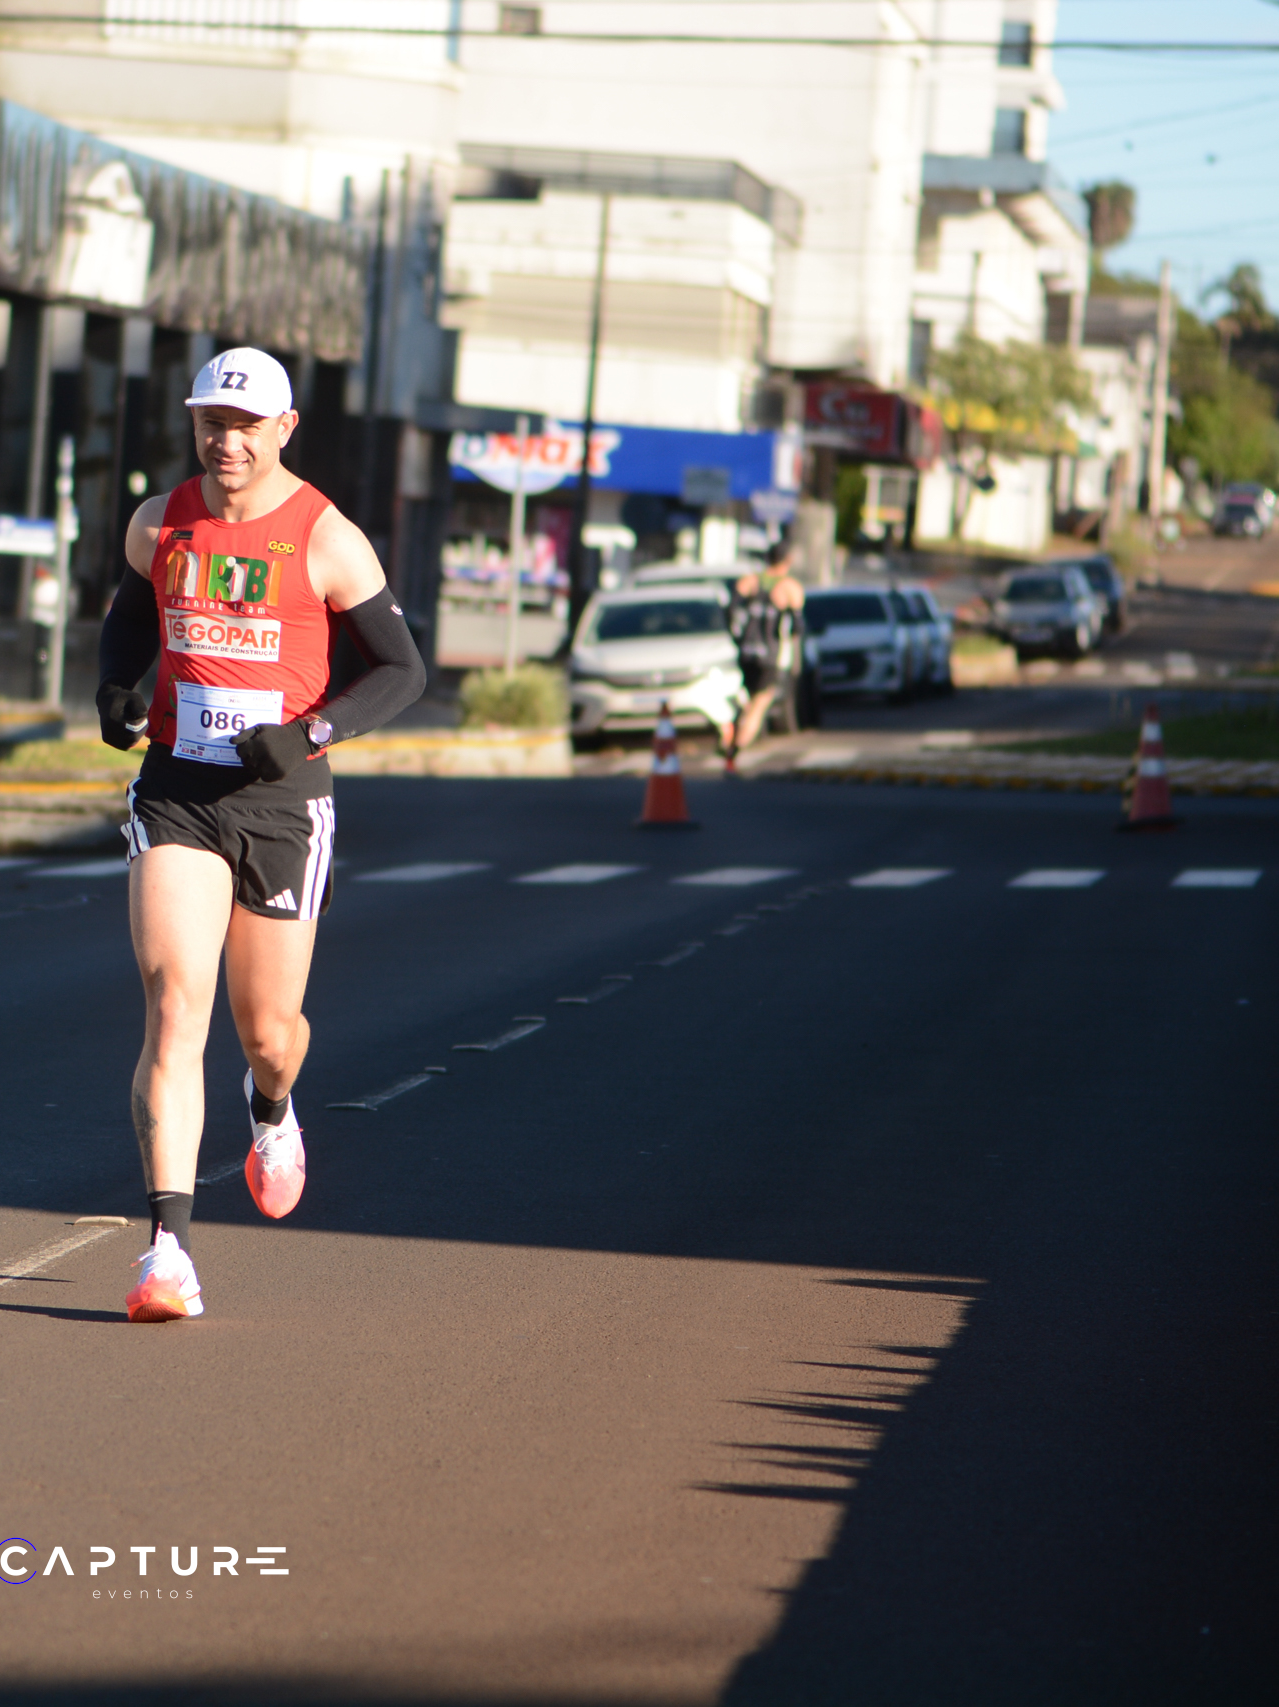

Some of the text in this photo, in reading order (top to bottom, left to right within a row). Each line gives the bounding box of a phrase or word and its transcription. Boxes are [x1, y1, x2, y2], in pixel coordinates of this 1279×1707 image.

[220, 371, 249, 391] Z2
[171, 597, 266, 614] running team
[184, 642, 219, 651] MATERIAIS
[200, 709, 247, 732] 086
